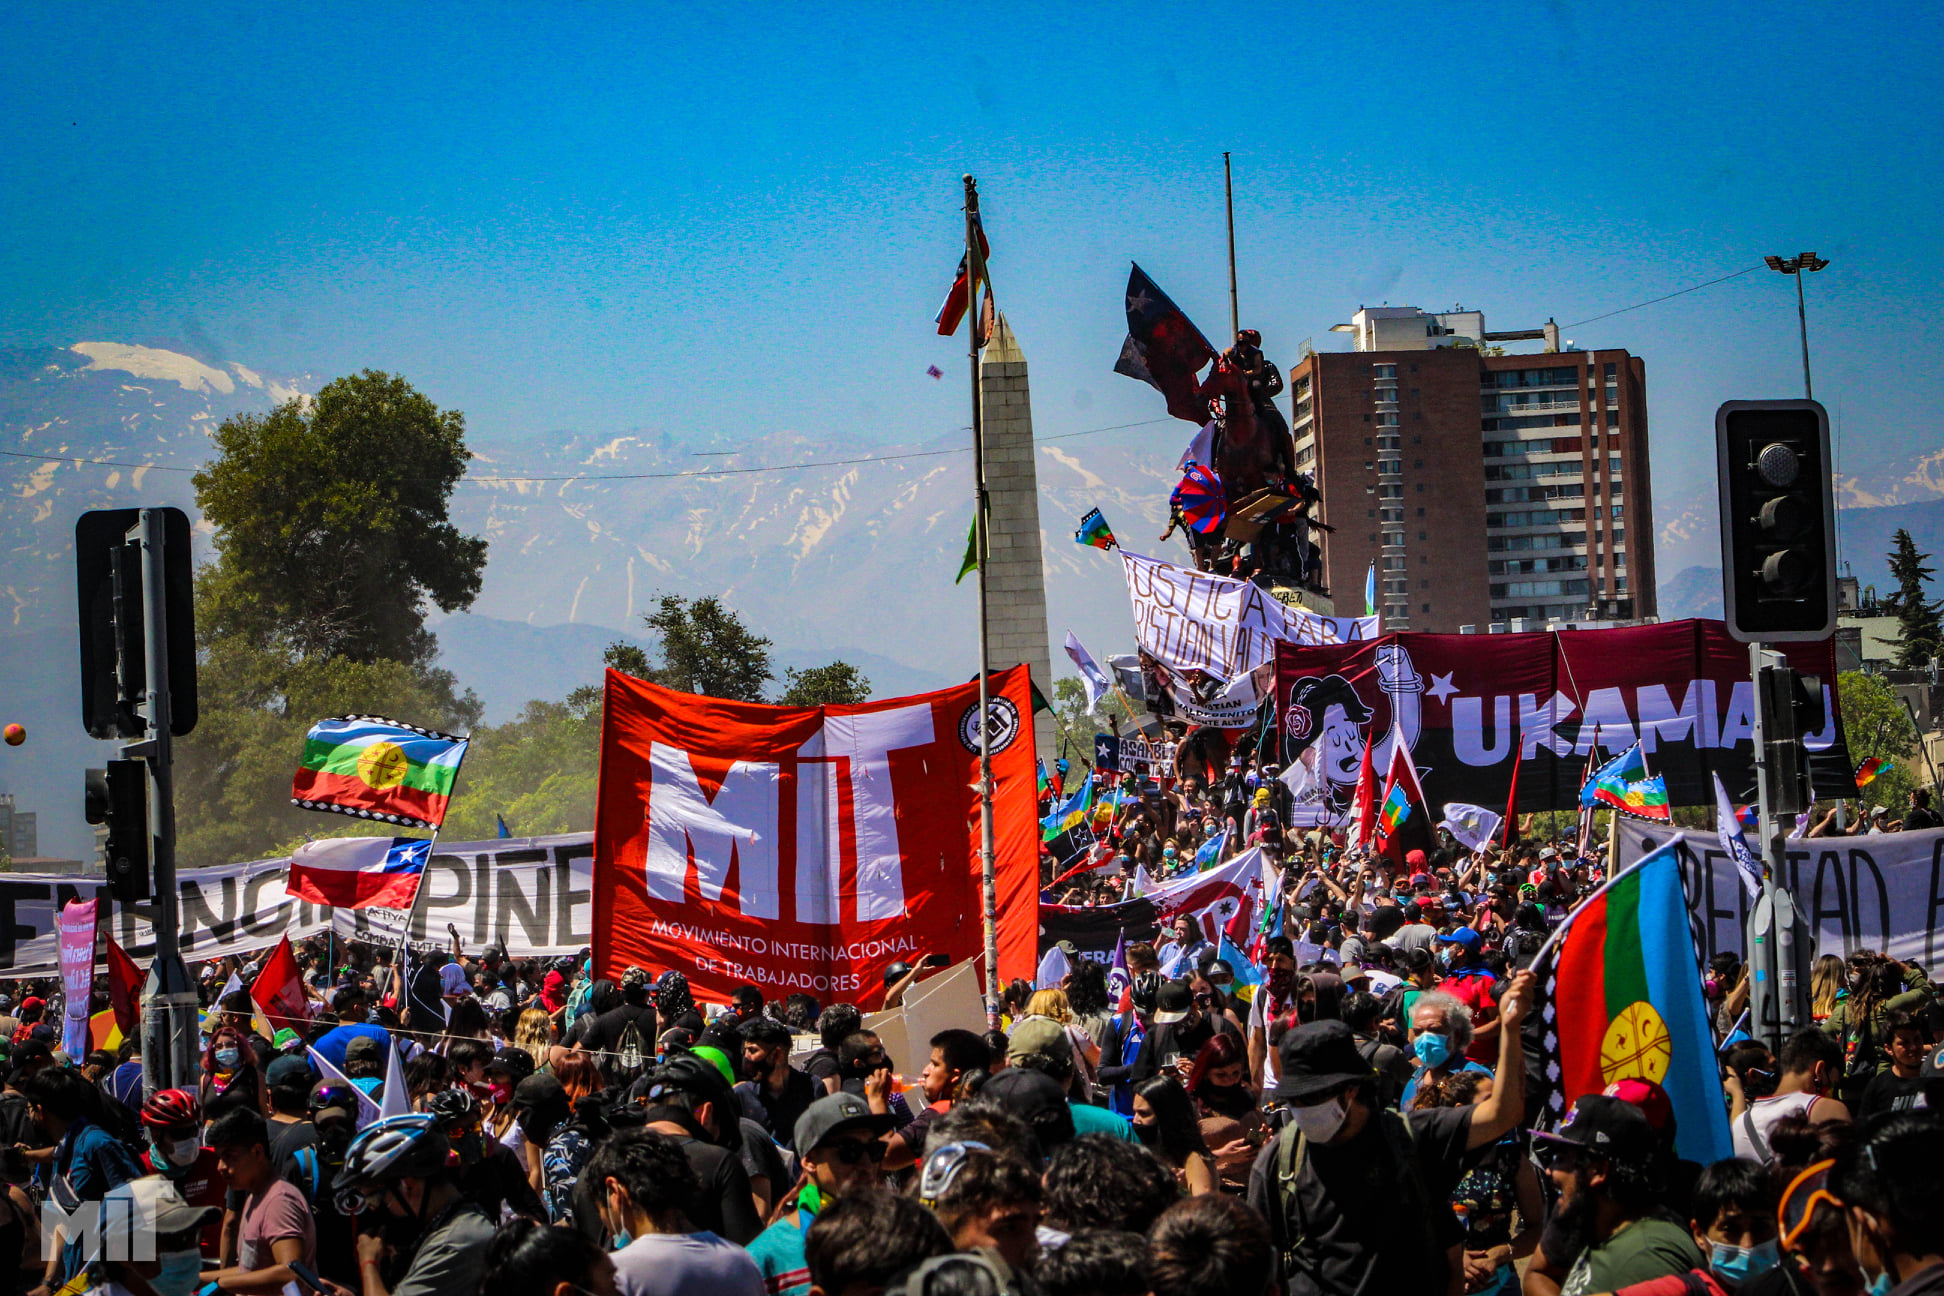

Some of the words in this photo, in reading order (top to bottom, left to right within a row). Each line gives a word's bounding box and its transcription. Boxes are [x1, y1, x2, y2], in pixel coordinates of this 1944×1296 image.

[1221, 718, 1245, 727] ALTO
[651, 919, 767, 954] MOVIMIENTO
[771, 935, 918, 962] INTERNACIONAL
[696, 956, 718, 973] DE
[723, 961, 861, 992] TRABAJADORES
